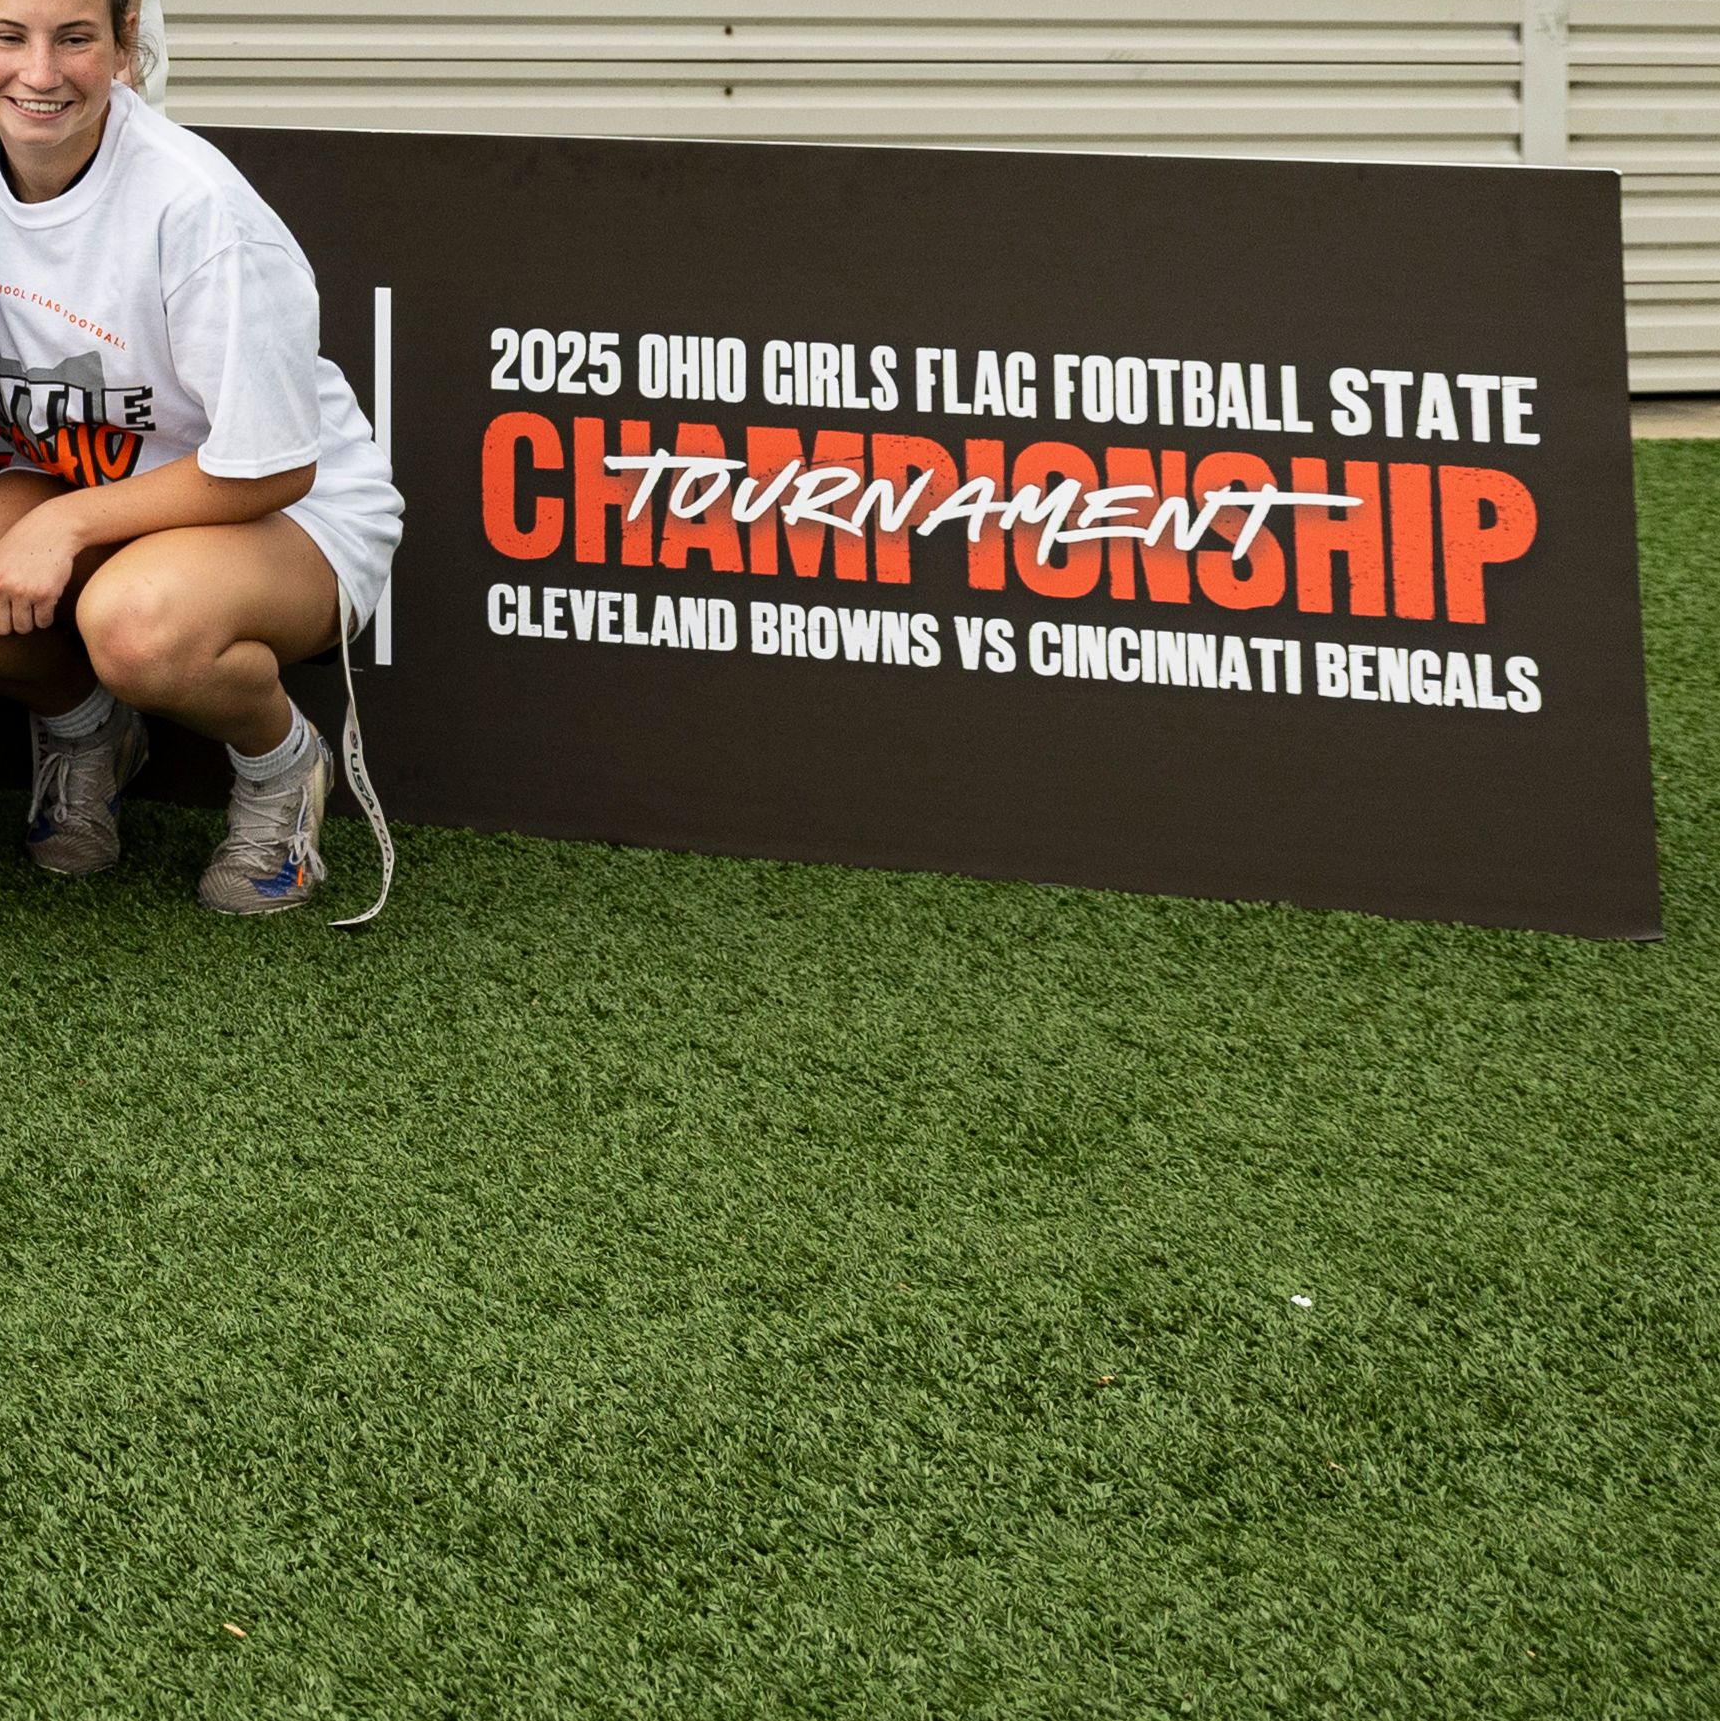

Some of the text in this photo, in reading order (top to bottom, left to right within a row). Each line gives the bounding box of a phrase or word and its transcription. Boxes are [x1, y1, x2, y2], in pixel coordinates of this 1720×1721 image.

[489, 327, 1541, 446] 2025 OHIO GIRLS FLAG FOOTBALL STATE
[481, 411, 1539, 626] CHAMPIONSHIP
[602, 451, 1364, 565] TOURNAMENT
[486, 582, 1541, 714] CLEVELAND BROWNS VS CINCINNATI BENGALS
